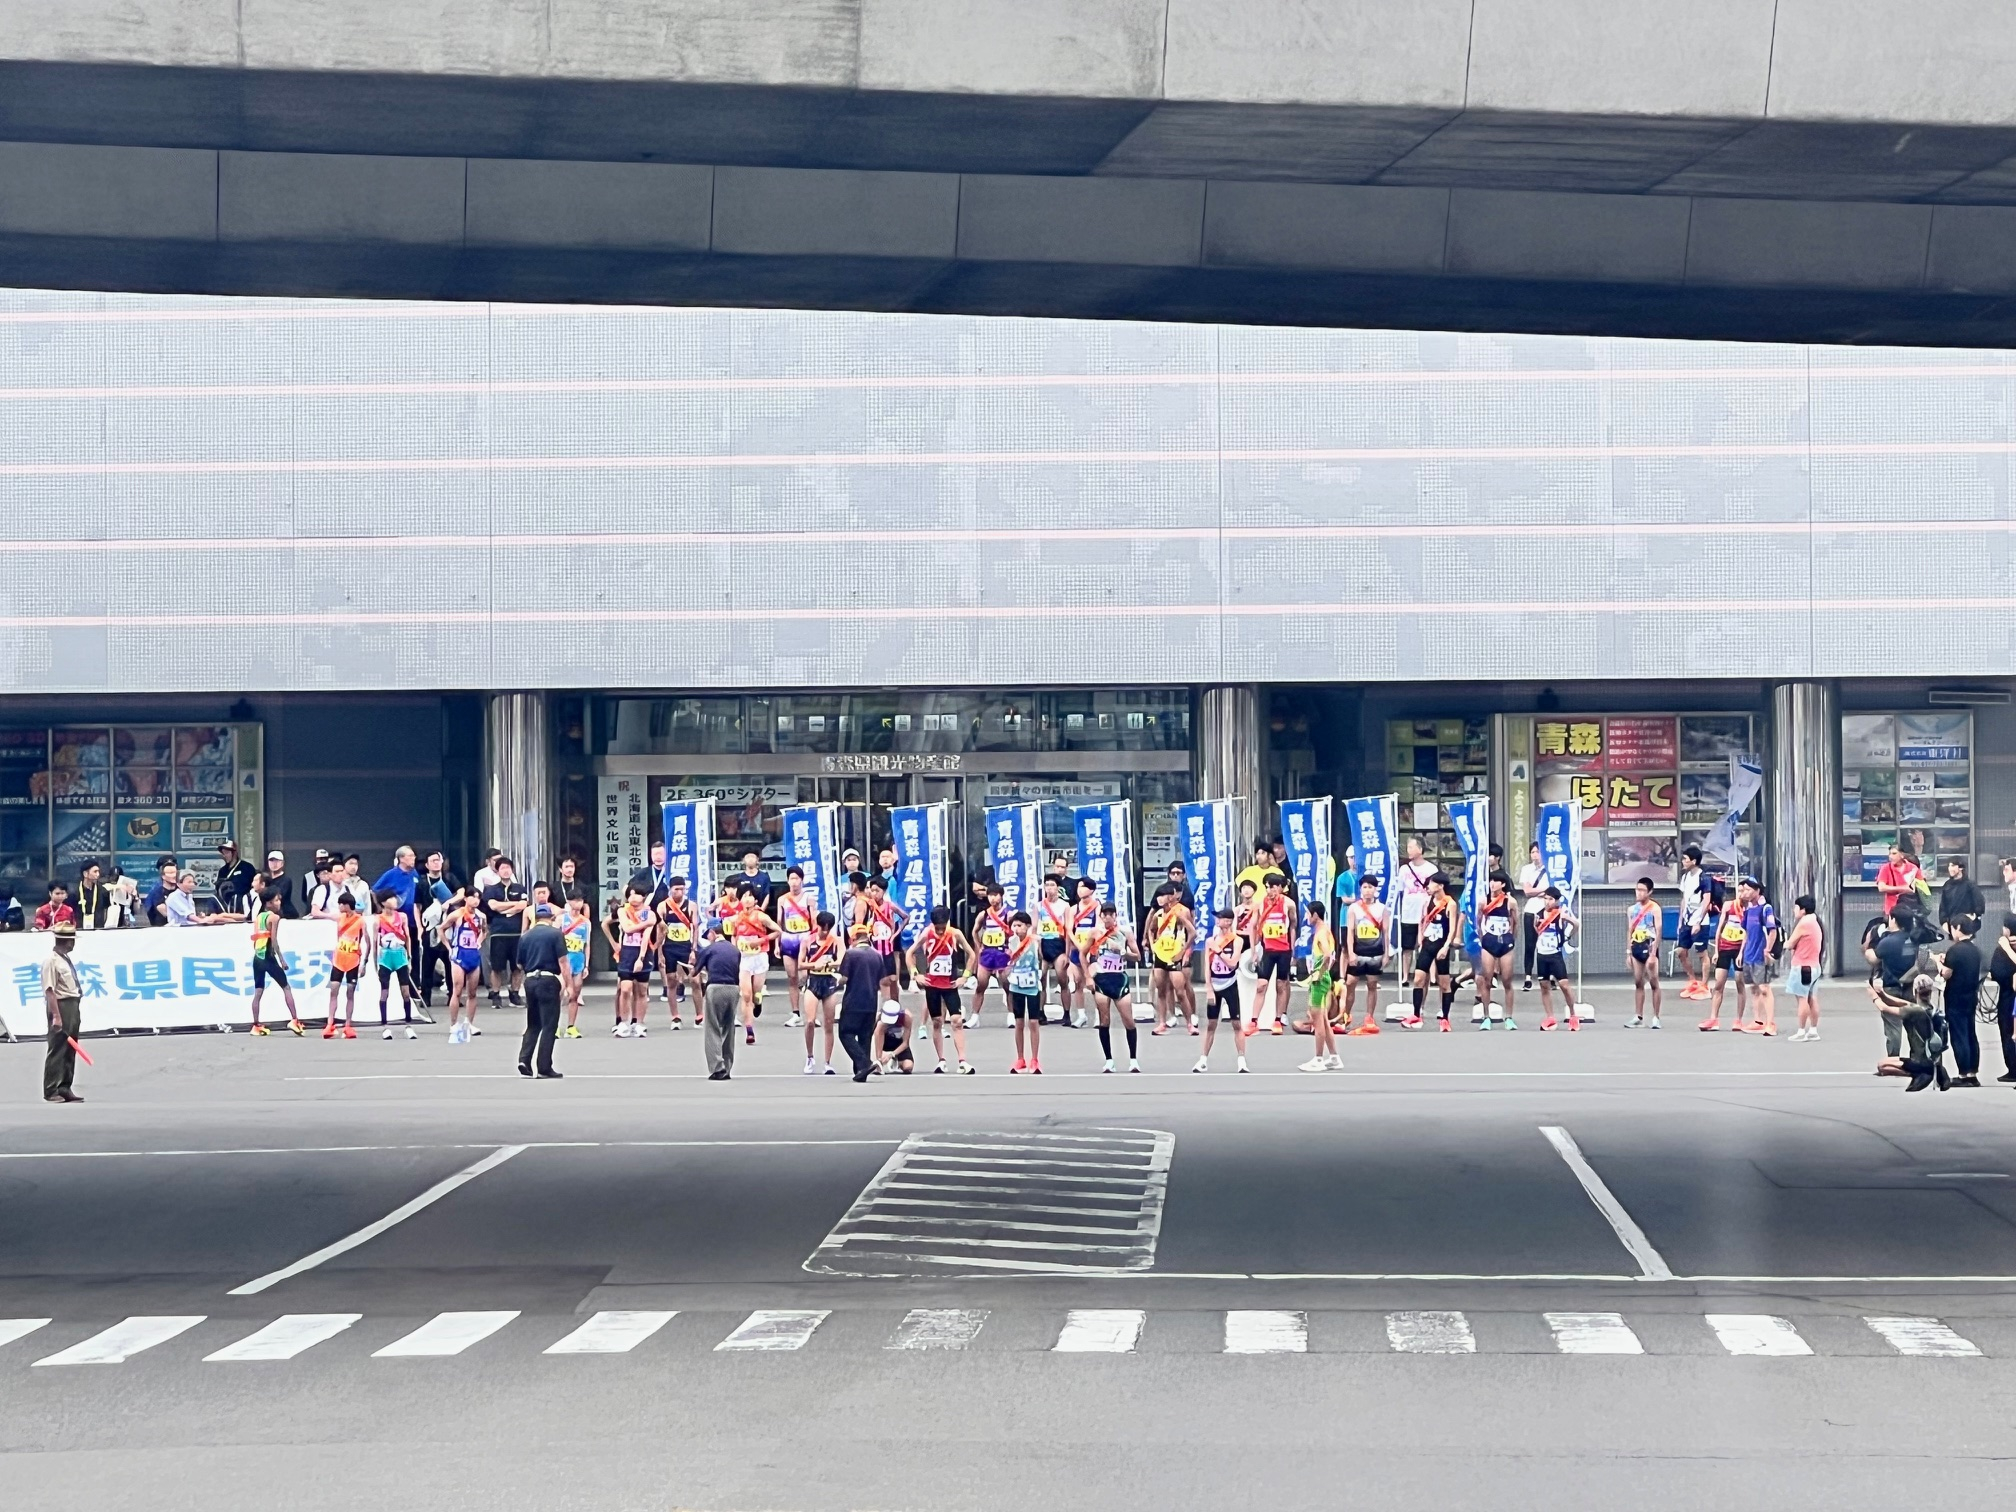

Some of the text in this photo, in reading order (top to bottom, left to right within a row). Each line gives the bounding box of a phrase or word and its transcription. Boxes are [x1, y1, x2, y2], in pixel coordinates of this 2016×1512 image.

[1536, 722, 1603, 755] 青森
[1571, 776, 1675, 808] ほたて
[670, 815, 692, 900] 青森県
[902, 819, 927, 940] 青森県民共
[933, 962, 940, 972] 2
[1103, 959, 1112, 970] 37
